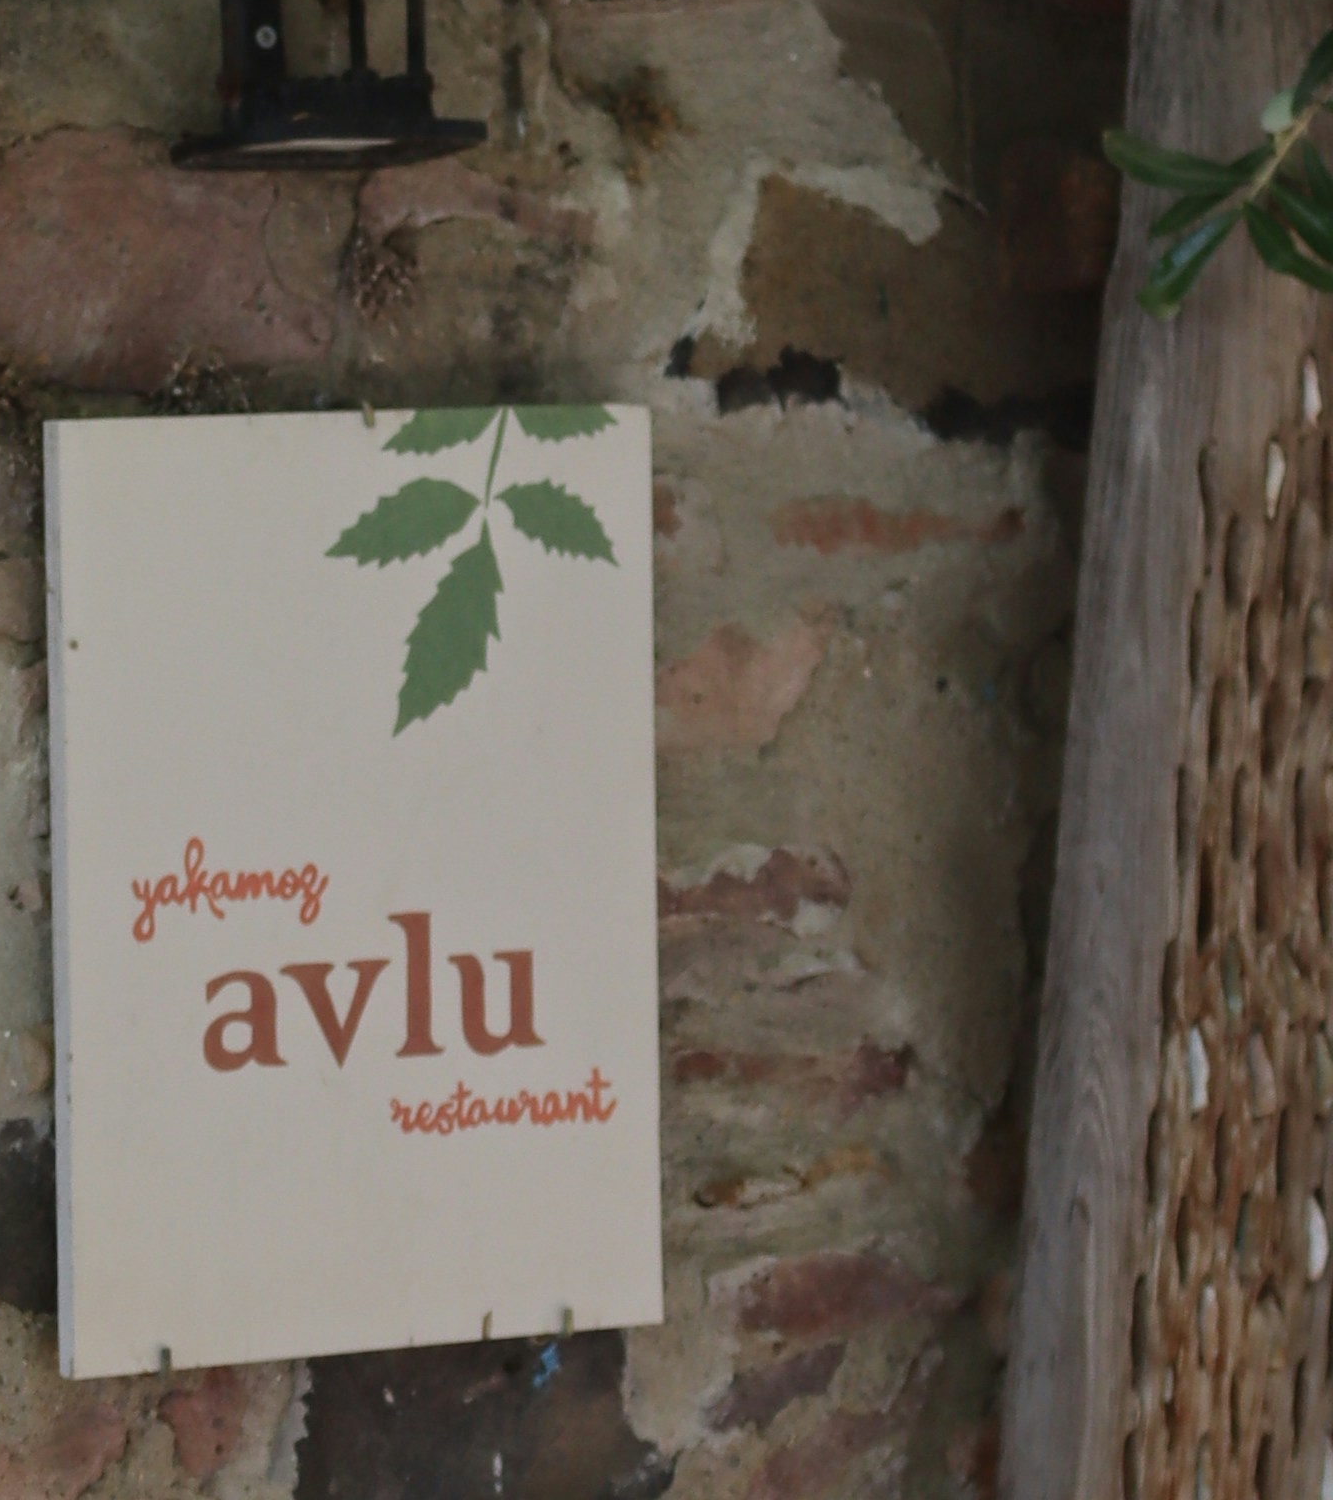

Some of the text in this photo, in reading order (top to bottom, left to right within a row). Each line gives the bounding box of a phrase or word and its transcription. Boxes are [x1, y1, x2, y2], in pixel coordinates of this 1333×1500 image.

[131, 836, 329, 943] yakamoz
[201, 911, 546, 1072] avlu
[390, 1067, 617, 1135] restaurant
